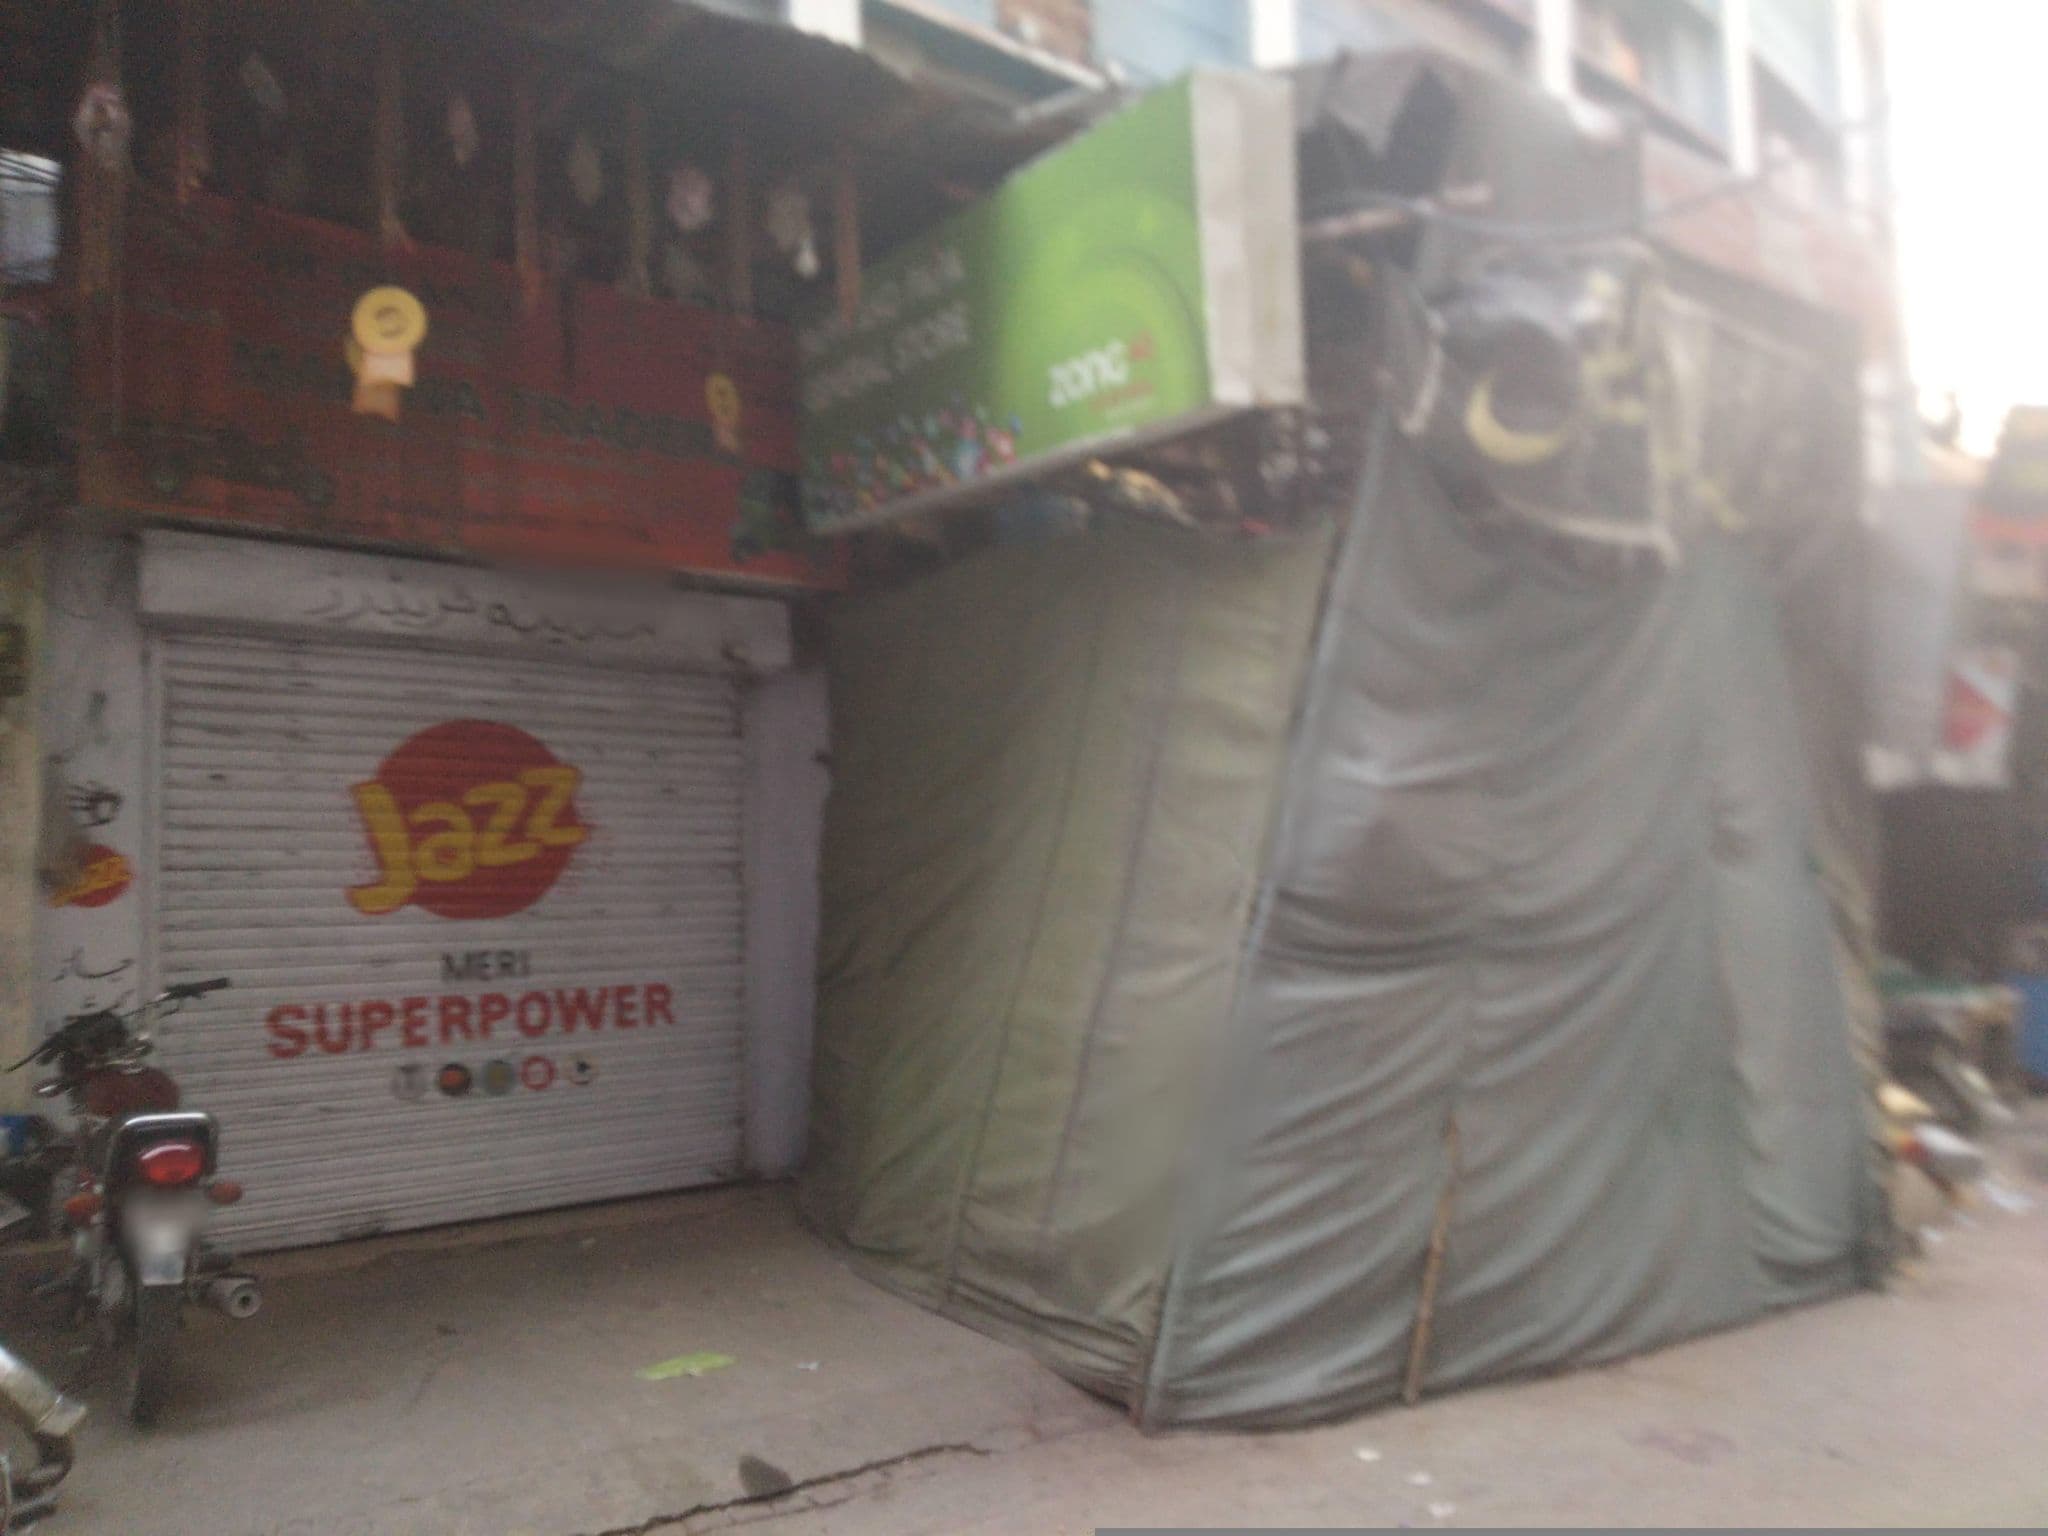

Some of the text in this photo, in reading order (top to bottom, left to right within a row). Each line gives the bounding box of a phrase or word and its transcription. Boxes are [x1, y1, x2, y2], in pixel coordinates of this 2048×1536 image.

[347, 767, 590, 913] Jazz
[441, 950, 531, 982] MERI
[266, 983, 675, 1058] SUPERPOWER
